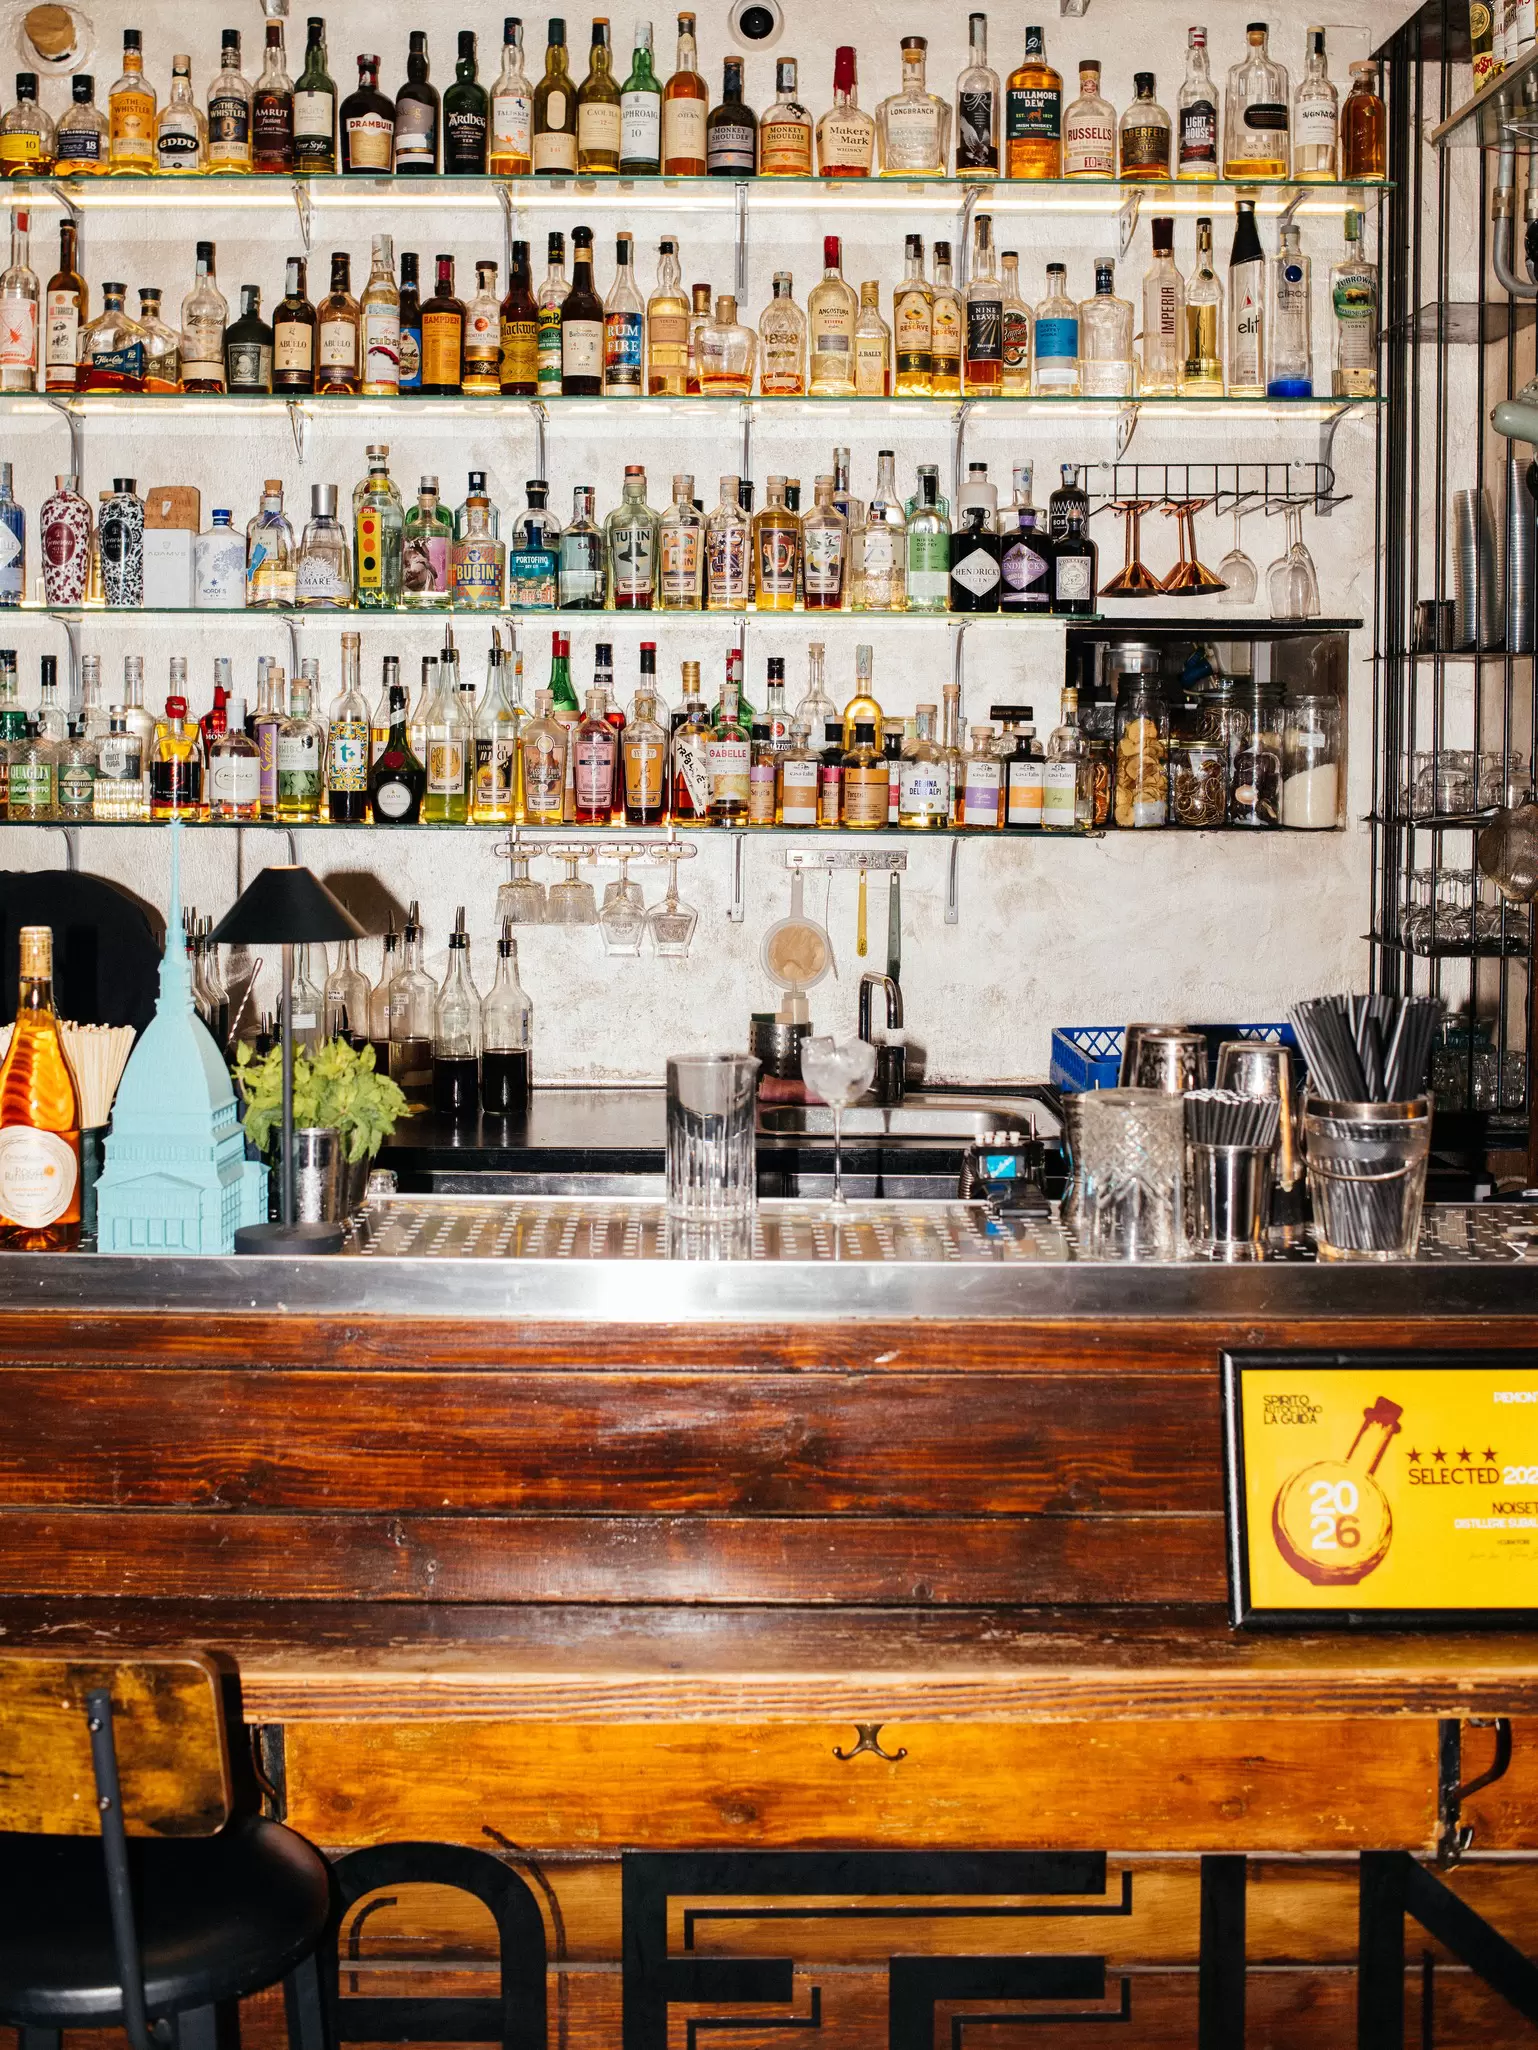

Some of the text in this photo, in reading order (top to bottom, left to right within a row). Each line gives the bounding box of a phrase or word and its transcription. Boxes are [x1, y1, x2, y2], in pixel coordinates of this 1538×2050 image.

[1012, 91, 1058, 100] TULLAMORE
[114, 105, 150, 114] WHISTLER
[210, 109, 246, 118] WHISTLER
[255, 109, 288, 118] AMRUT
[890, 108, 934, 116] LONGBRANCH
[350, 120, 392, 131] DRAMBUIE
[1186, 116, 1206, 127] LIGHT
[632, 129, 641, 137] 10
[830, 126, 870, 136] Maker's
[1068, 128, 1112, 141] RUSSELL'S
[1186, 128, 1209, 139] HOUSE
[25, 141, 36, 149] 10
[841, 136, 868, 145] Mark
[85, 141, 97, 150] 18
[1086, 157, 1096, 167] 10
[818, 308, 849, 316] ANGOSTURA
[424, 316, 460, 324] HAMPDEN
[607, 325, 638, 336] RUM
[279, 340, 307, 348] ABUELO
[324, 340, 350, 348] ABUELO
[607, 341, 638, 352] FIRE
[516, 556, 548, 564] PORTOFINO
[1003, 562, 1045, 570] ENDRICK'S
[457, 564, 494, 580] BUGIN
[955, 568, 1000, 576] HENDRICK'S
[710, 749, 746, 758] GABELLE
[11, 766, 48, 779] QUAGLIA
[1264, 1395, 1310, 1406] SPIRITO
[1264, 1414, 1317, 1425] LA GUIDA
[1409, 1468, 1500, 1485] SELECTED
[1308, 1480, 1359, 1515] 20
[1310, 1515, 1361, 1550] 26
